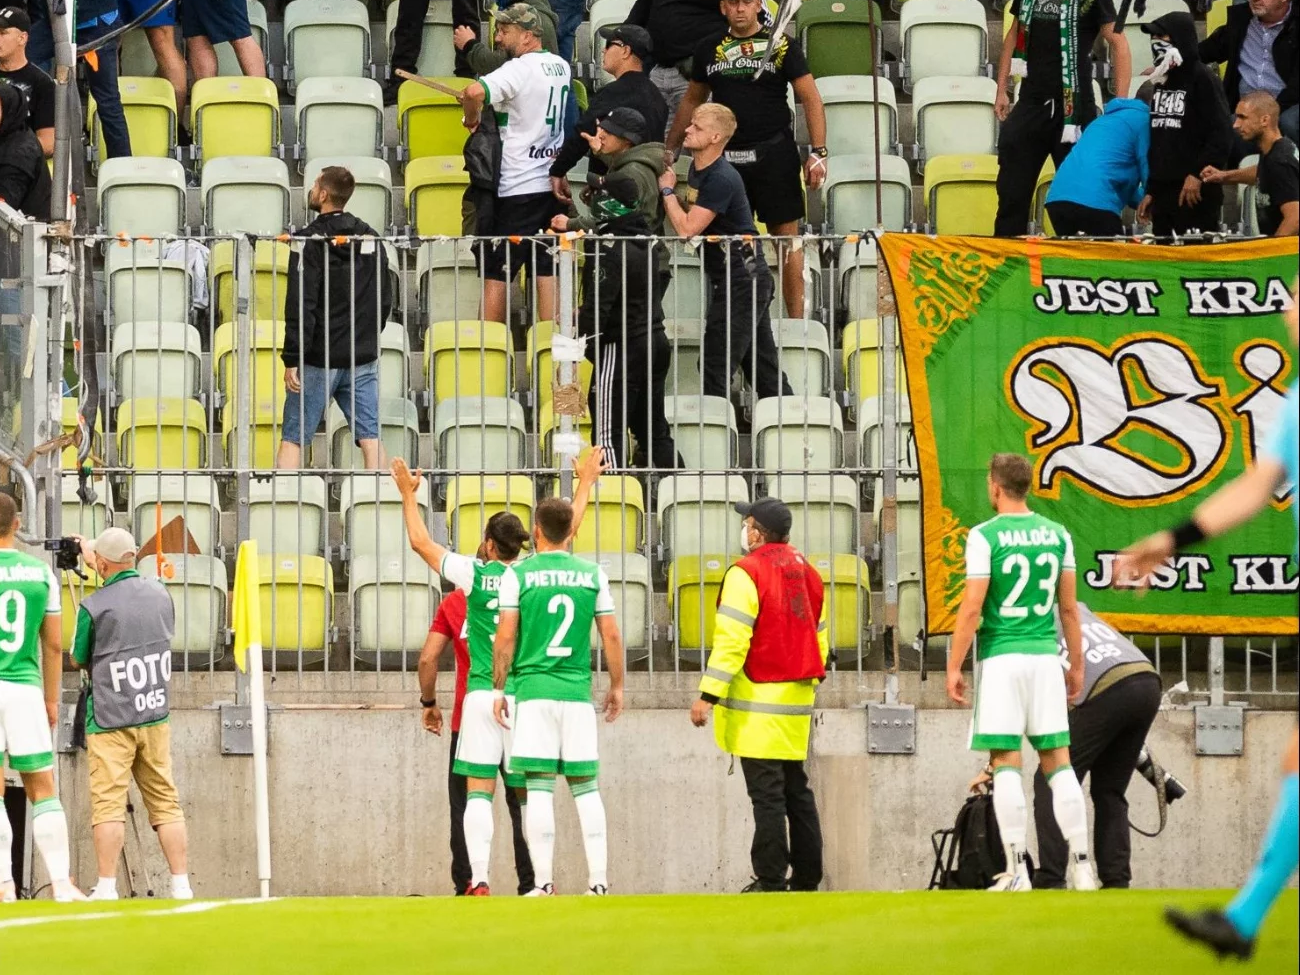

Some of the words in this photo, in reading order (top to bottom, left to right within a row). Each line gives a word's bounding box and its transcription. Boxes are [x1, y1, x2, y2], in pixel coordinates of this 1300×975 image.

[735, 58, 776, 74] Gdask
[1035, 278, 1159, 315] JEST
[997, 527, 1059, 547] MALOČA
[524, 570, 595, 589] PIETRZAK
[1000, 552, 1060, 618] 23
[1232, 557, 1300, 593] KL
[545, 594, 576, 657] 2
[109, 649, 172, 693] FOTO
[134, 688, 166, 712] 065
